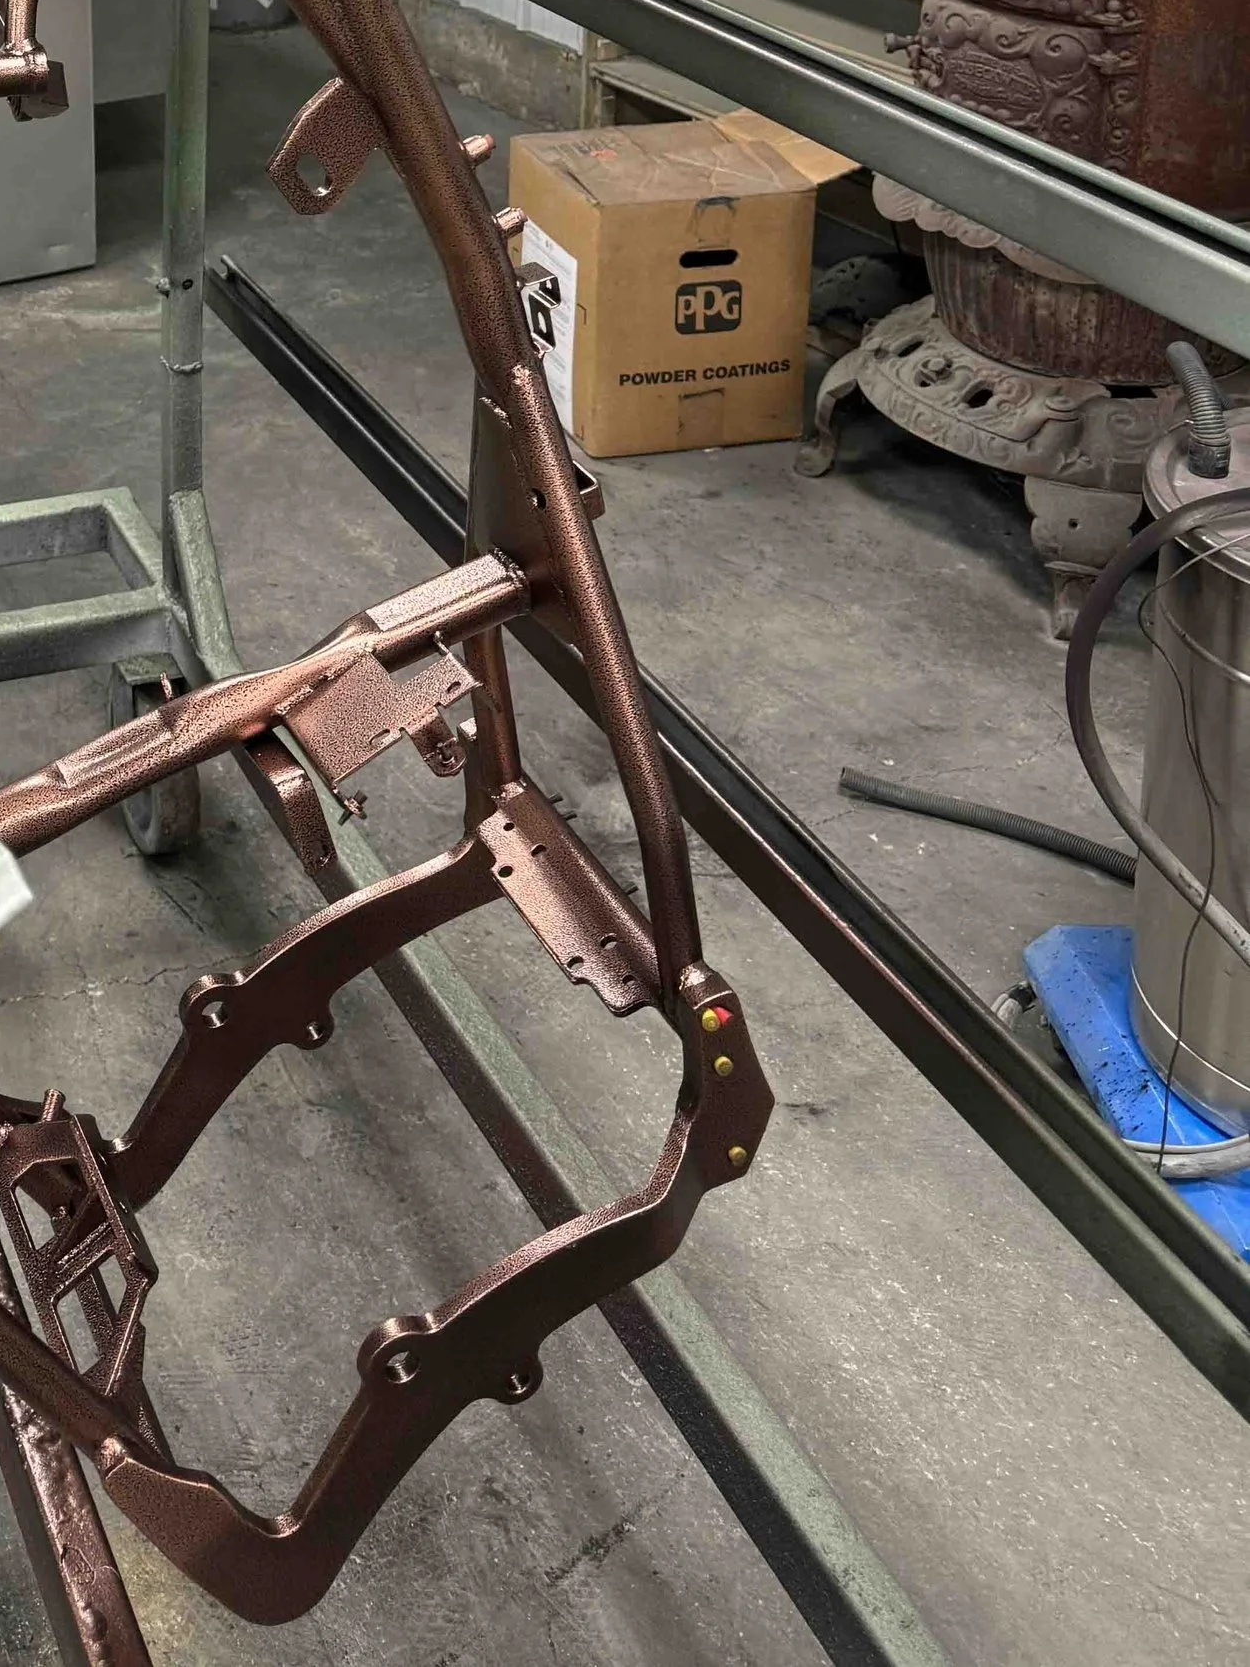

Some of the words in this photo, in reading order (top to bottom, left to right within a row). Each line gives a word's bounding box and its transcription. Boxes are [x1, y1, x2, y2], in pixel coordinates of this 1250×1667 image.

[677, 285, 740, 331] PPG
[619, 369, 697, 386] POWDER
[703, 359, 791, 380] COATINGS
